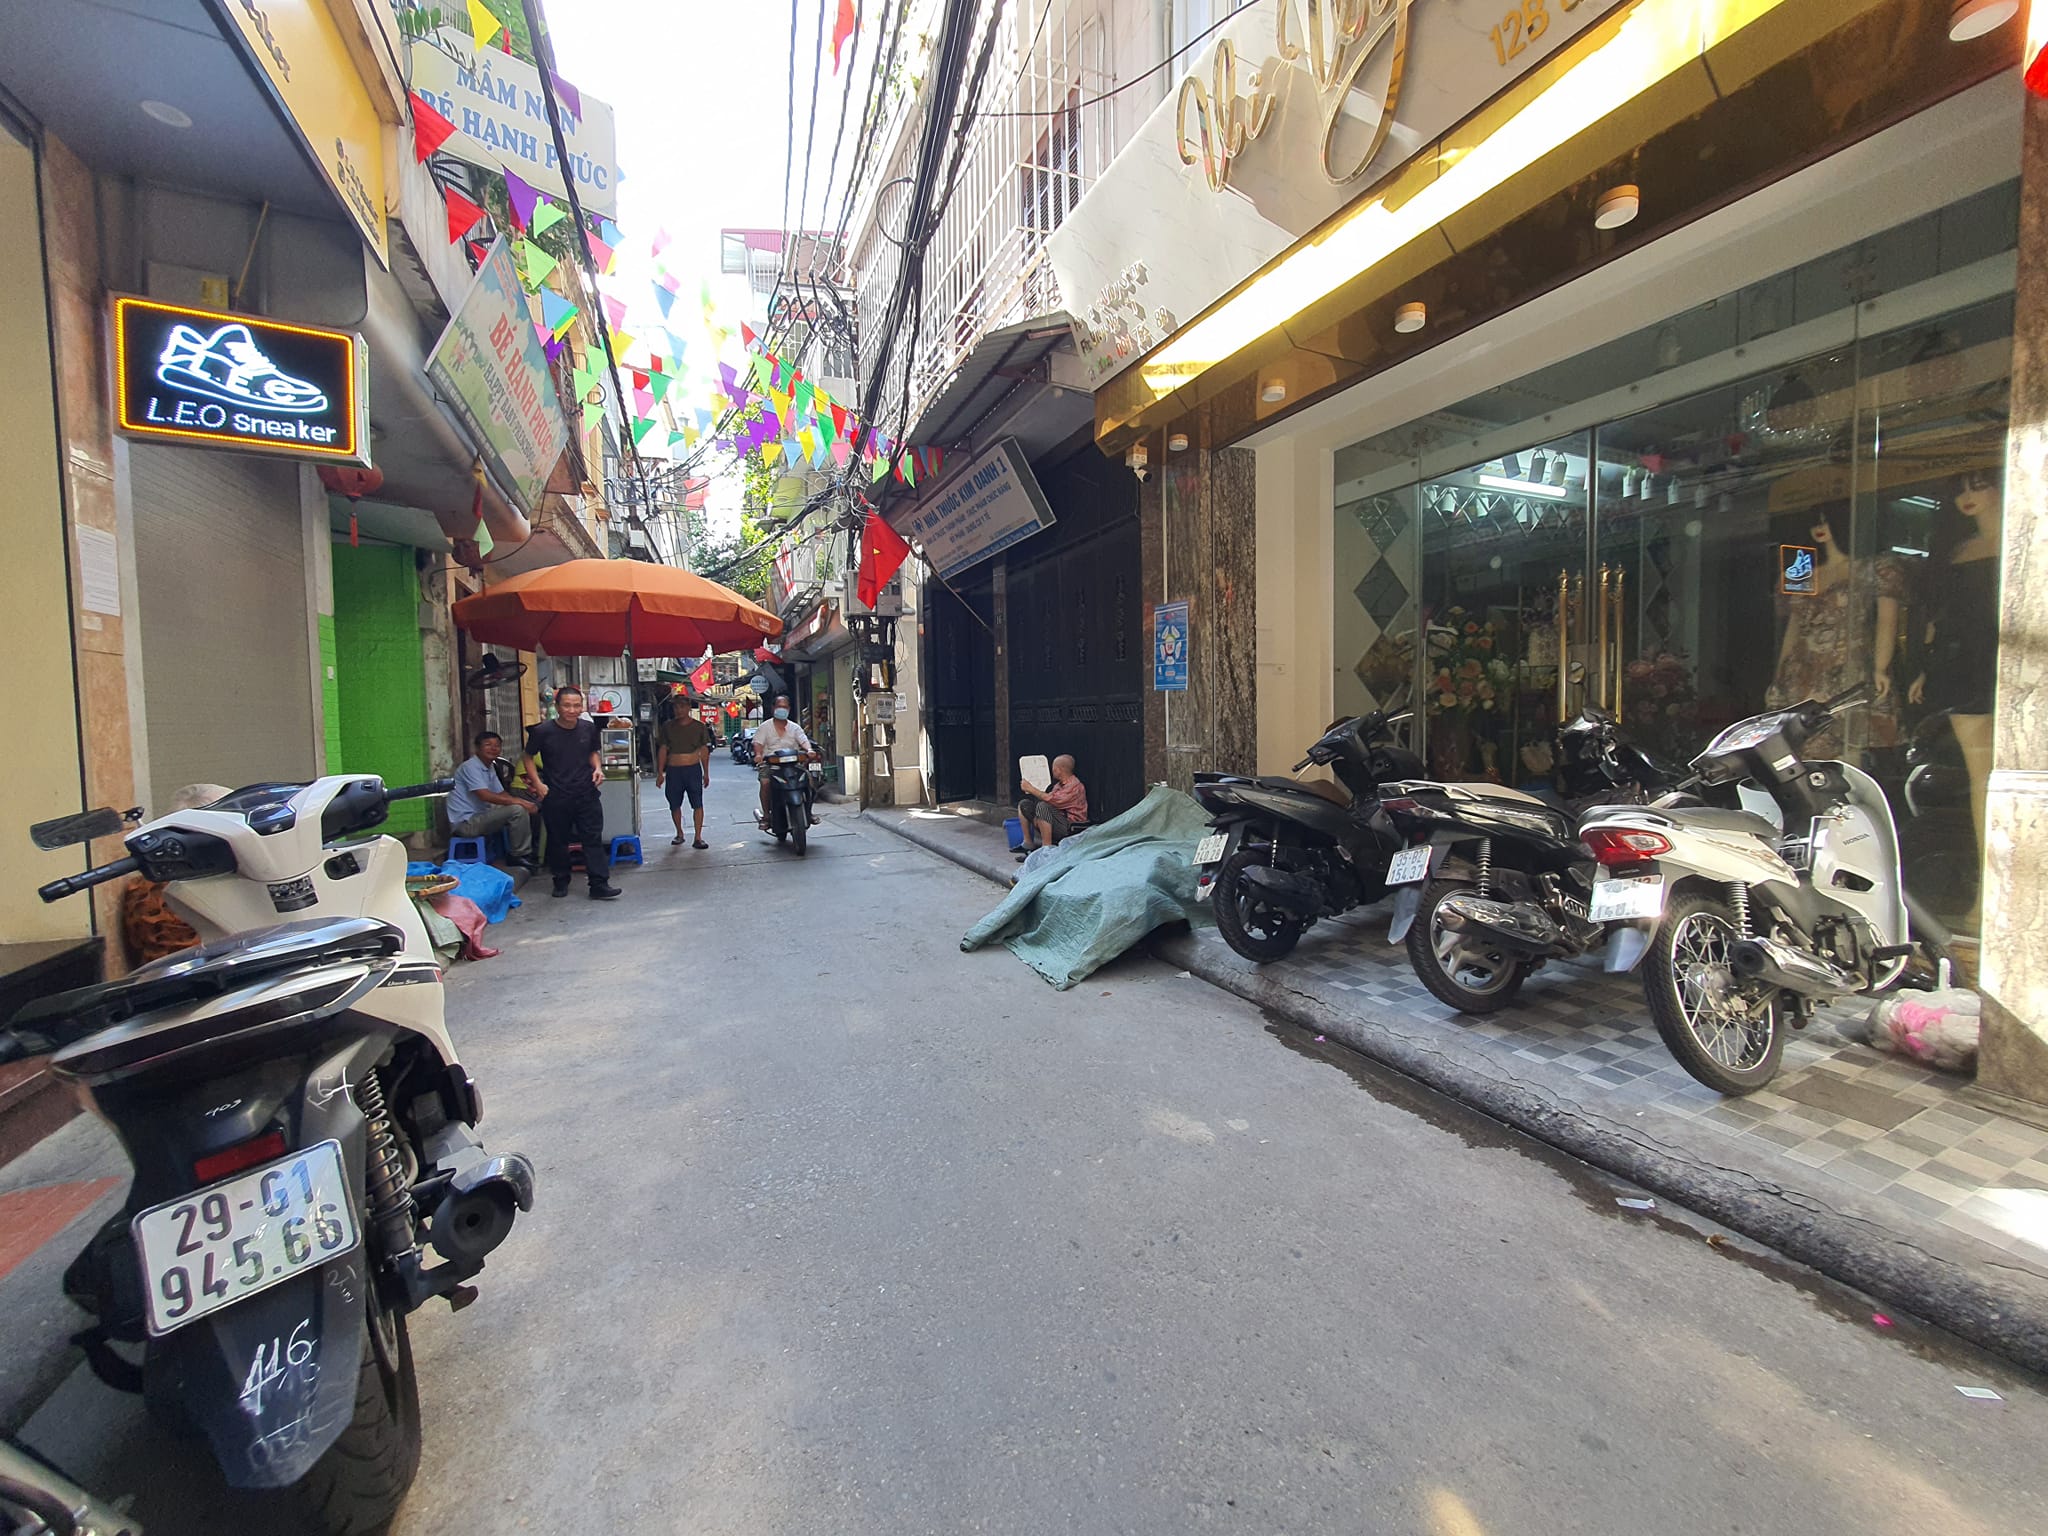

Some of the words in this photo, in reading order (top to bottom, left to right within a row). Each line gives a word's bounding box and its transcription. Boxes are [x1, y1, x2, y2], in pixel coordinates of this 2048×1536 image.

[1489, 0, 1550, 65] 12B
[457, 60, 517, 110] MẦM
[463, 107, 537, 162] HẠNH
[489, 312, 517, 362] BÉ
[959, 480, 977, 503] KIM
[972, 461, 1000, 490] OANH
[997, 456, 1008, 473] 1
[171, 1160, 314, 1257] 29-G1
[161, 1203, 344, 1318] 945.66
